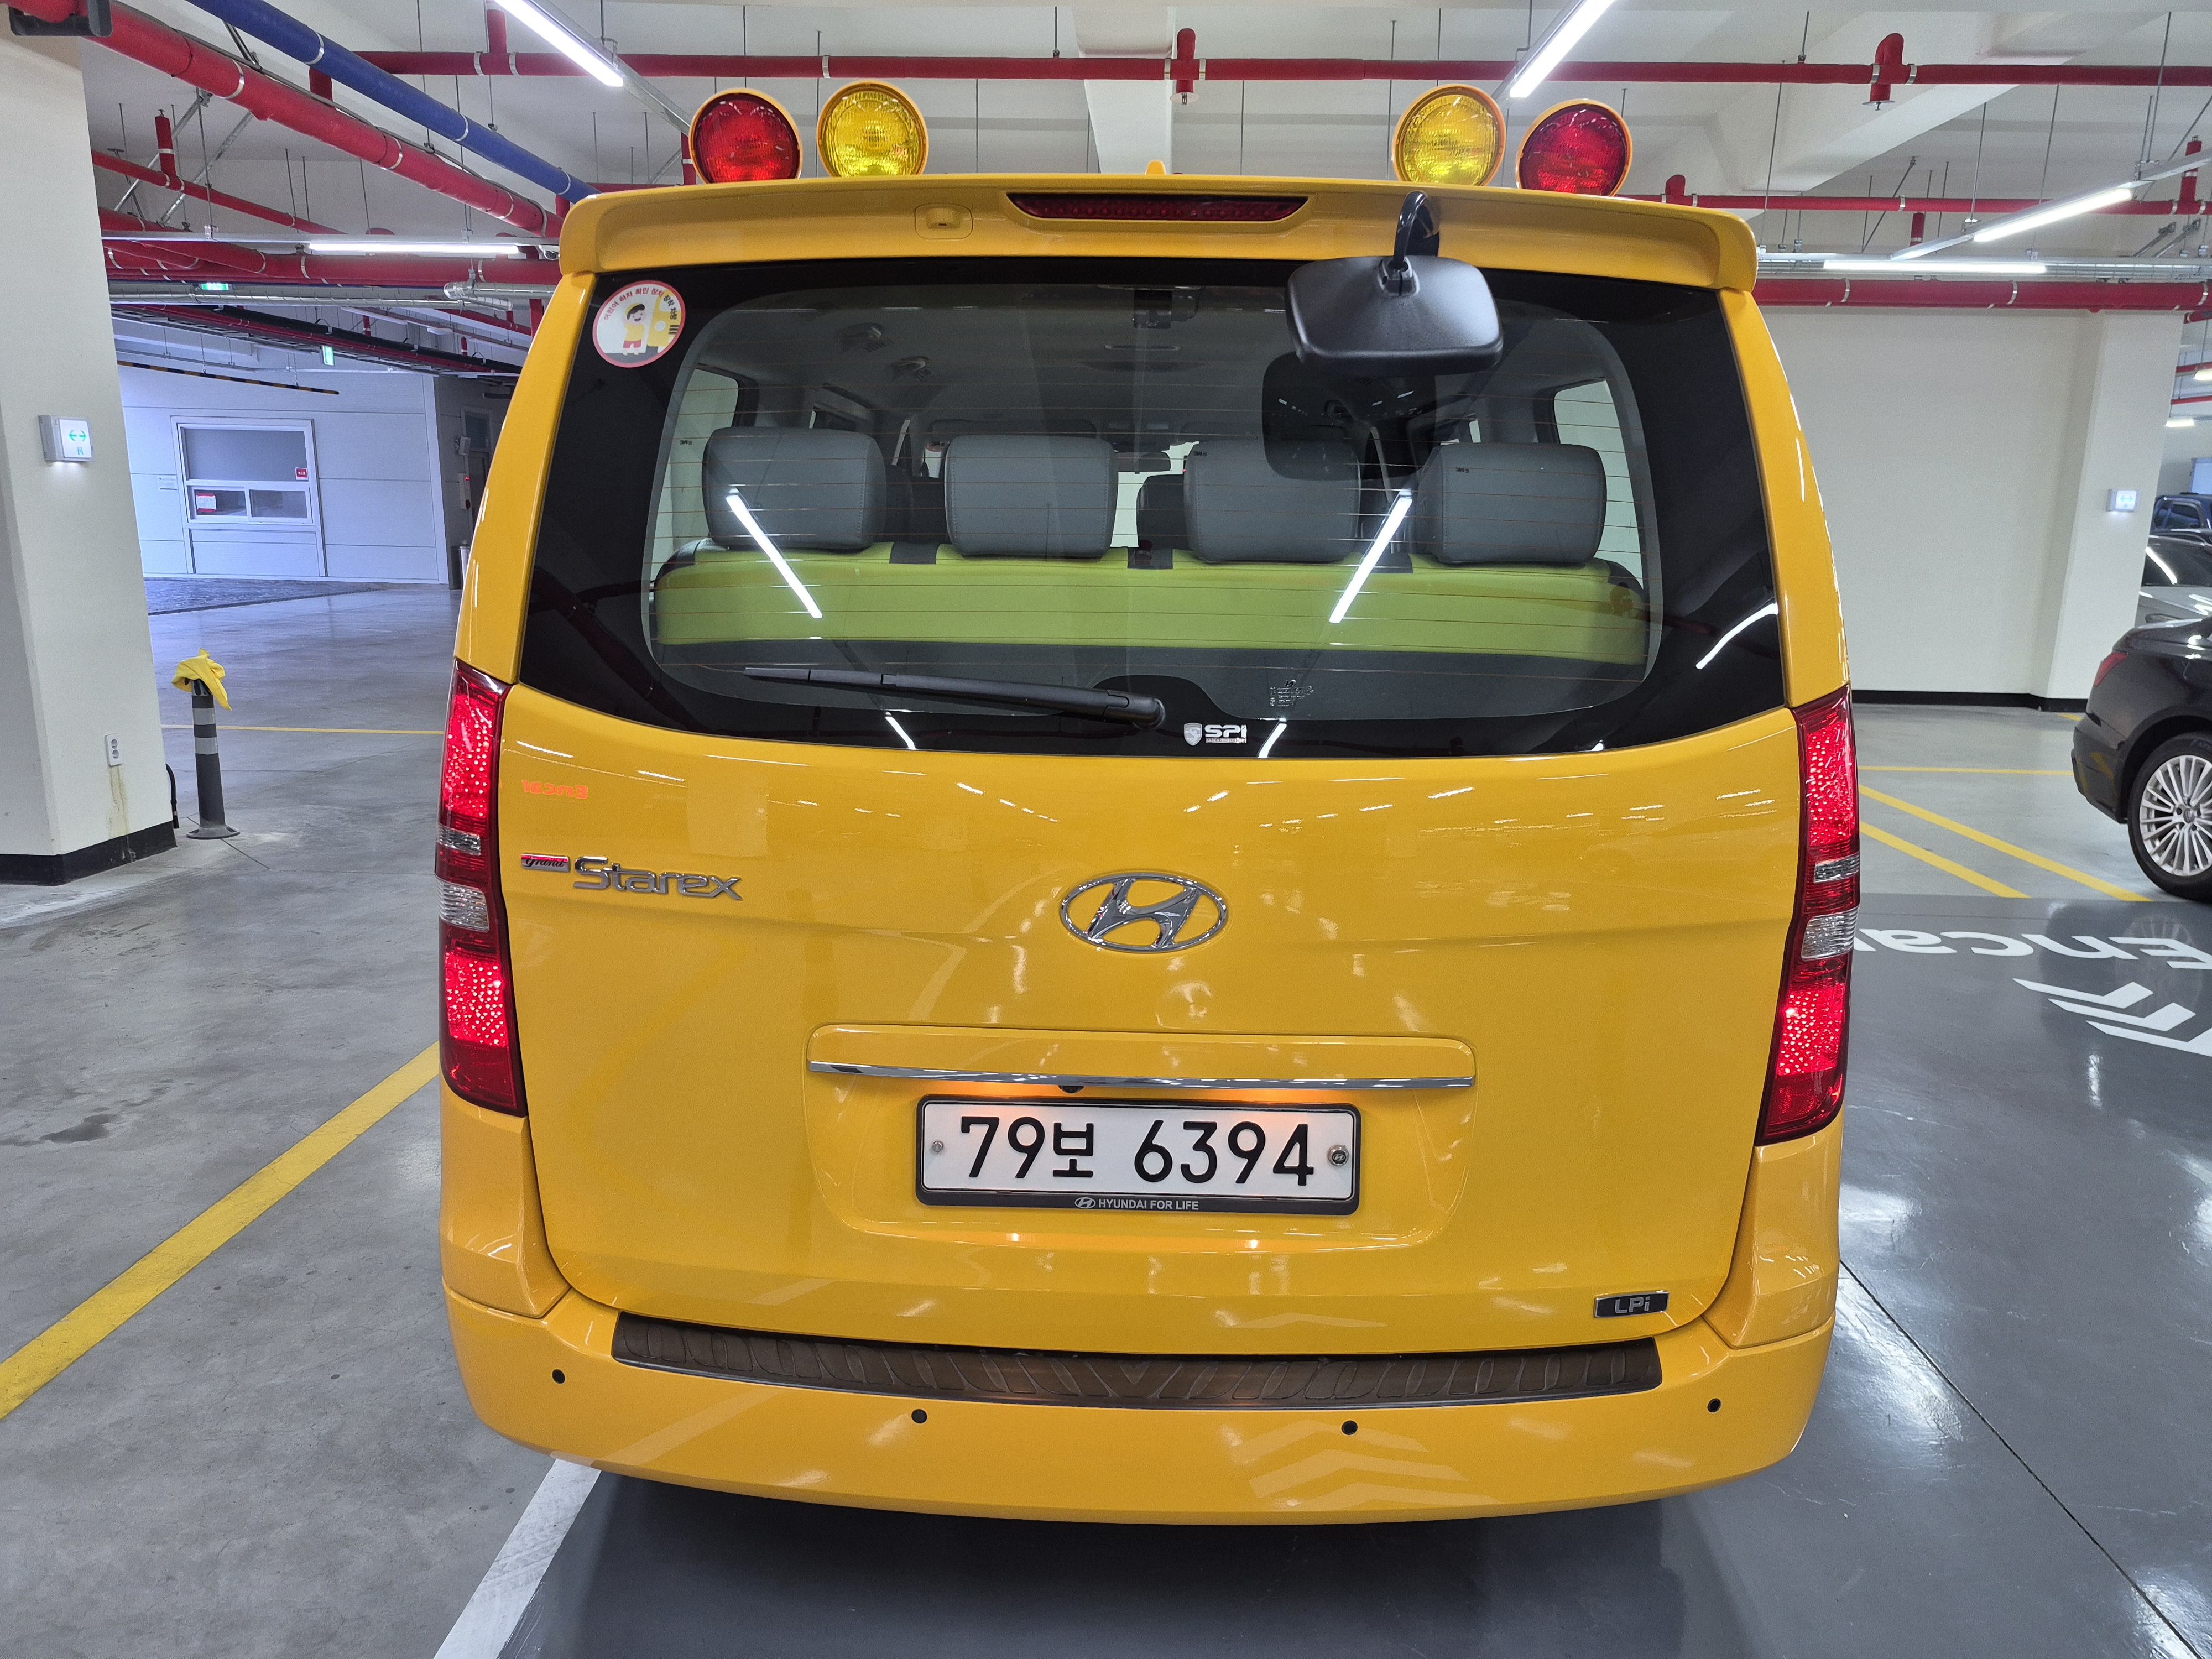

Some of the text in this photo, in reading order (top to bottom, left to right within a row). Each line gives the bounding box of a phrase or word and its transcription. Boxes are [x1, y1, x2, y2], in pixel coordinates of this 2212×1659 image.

[604, 301, 619, 320] 어린이
[619, 291, 633, 301] 하차
[651, 288, 664, 298] 장치
[1204, 724, 1247, 738] SPI
[573, 855, 743, 901] Starex
[961, 1116, 1314, 1186] 79보 6394
[1098, 1198, 1199, 1211] HYUNDAI FOR LIFE
[1614, 1296, 1651, 1314] LPi
